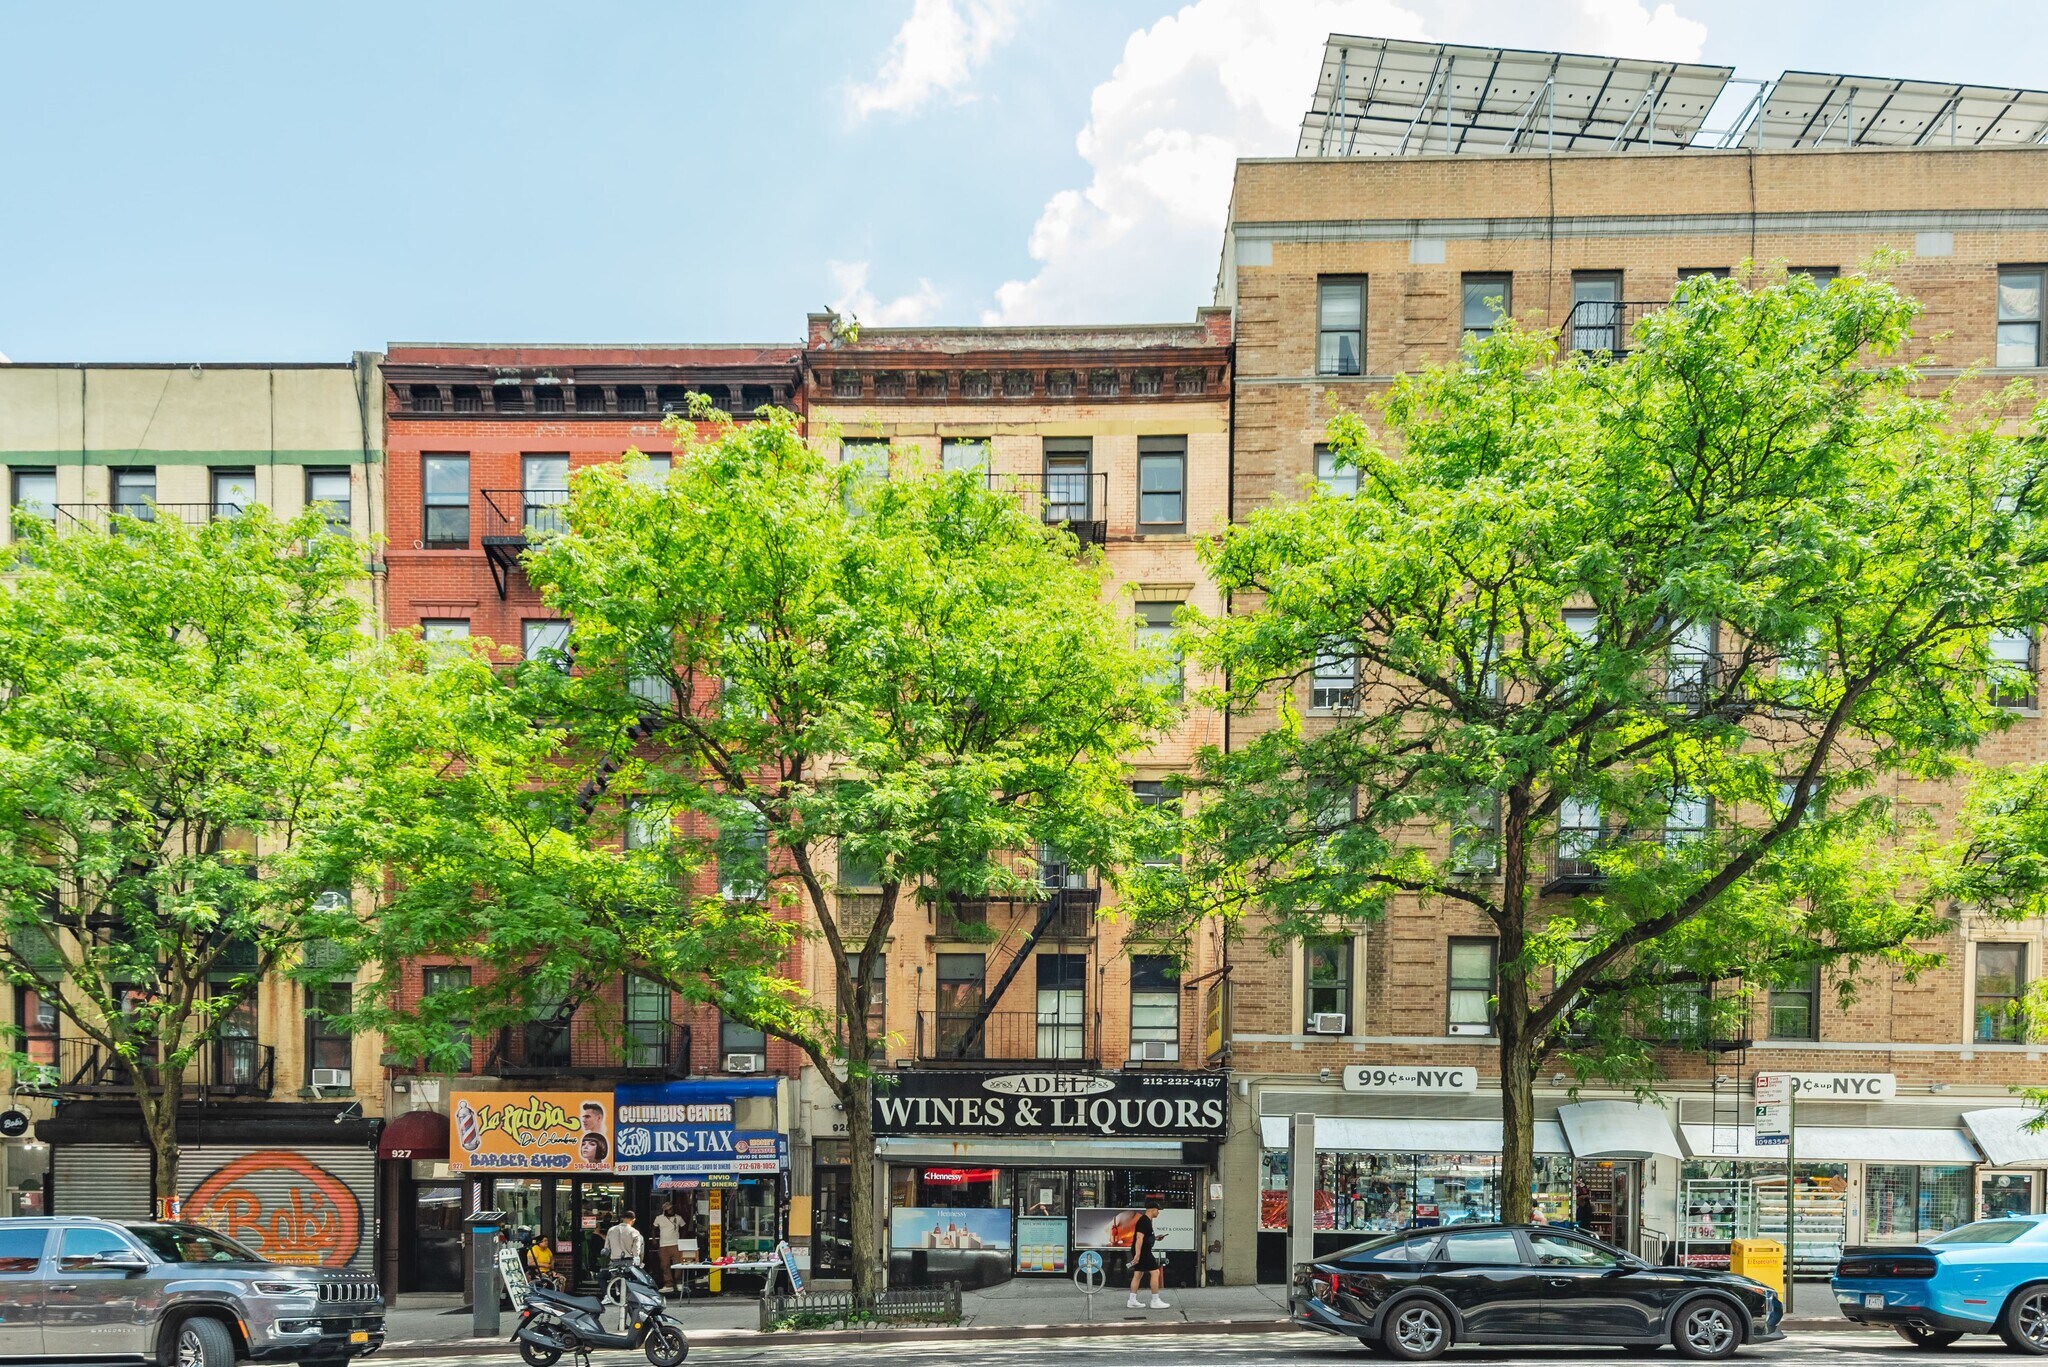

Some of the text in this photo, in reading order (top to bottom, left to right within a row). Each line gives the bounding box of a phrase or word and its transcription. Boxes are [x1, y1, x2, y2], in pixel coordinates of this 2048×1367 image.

[1015, 1076, 1085, 1094] ADEL
[1142, 1077, 1221, 1087] 212-222-4157
[1417, 1071, 1463, 1087] NYC
[1833, 1078, 1881, 1094] NYC
[477, 1105, 500, 1136] La
[619, 1104, 732, 1123] COLUMBUS CENTER
[876, 1097, 1224, 1134] WINES & LIQUORS
[654, 1130, 733, 1153] IRS-TAX
[391, 1150, 412, 1158] 927
[469, 1153, 572, 1169] BARBER SHOP
[930, 1173, 962, 1181] Hennessy
[212, 1187, 336, 1253] Bob's
[937, 1210, 967, 1218] Hennessy
